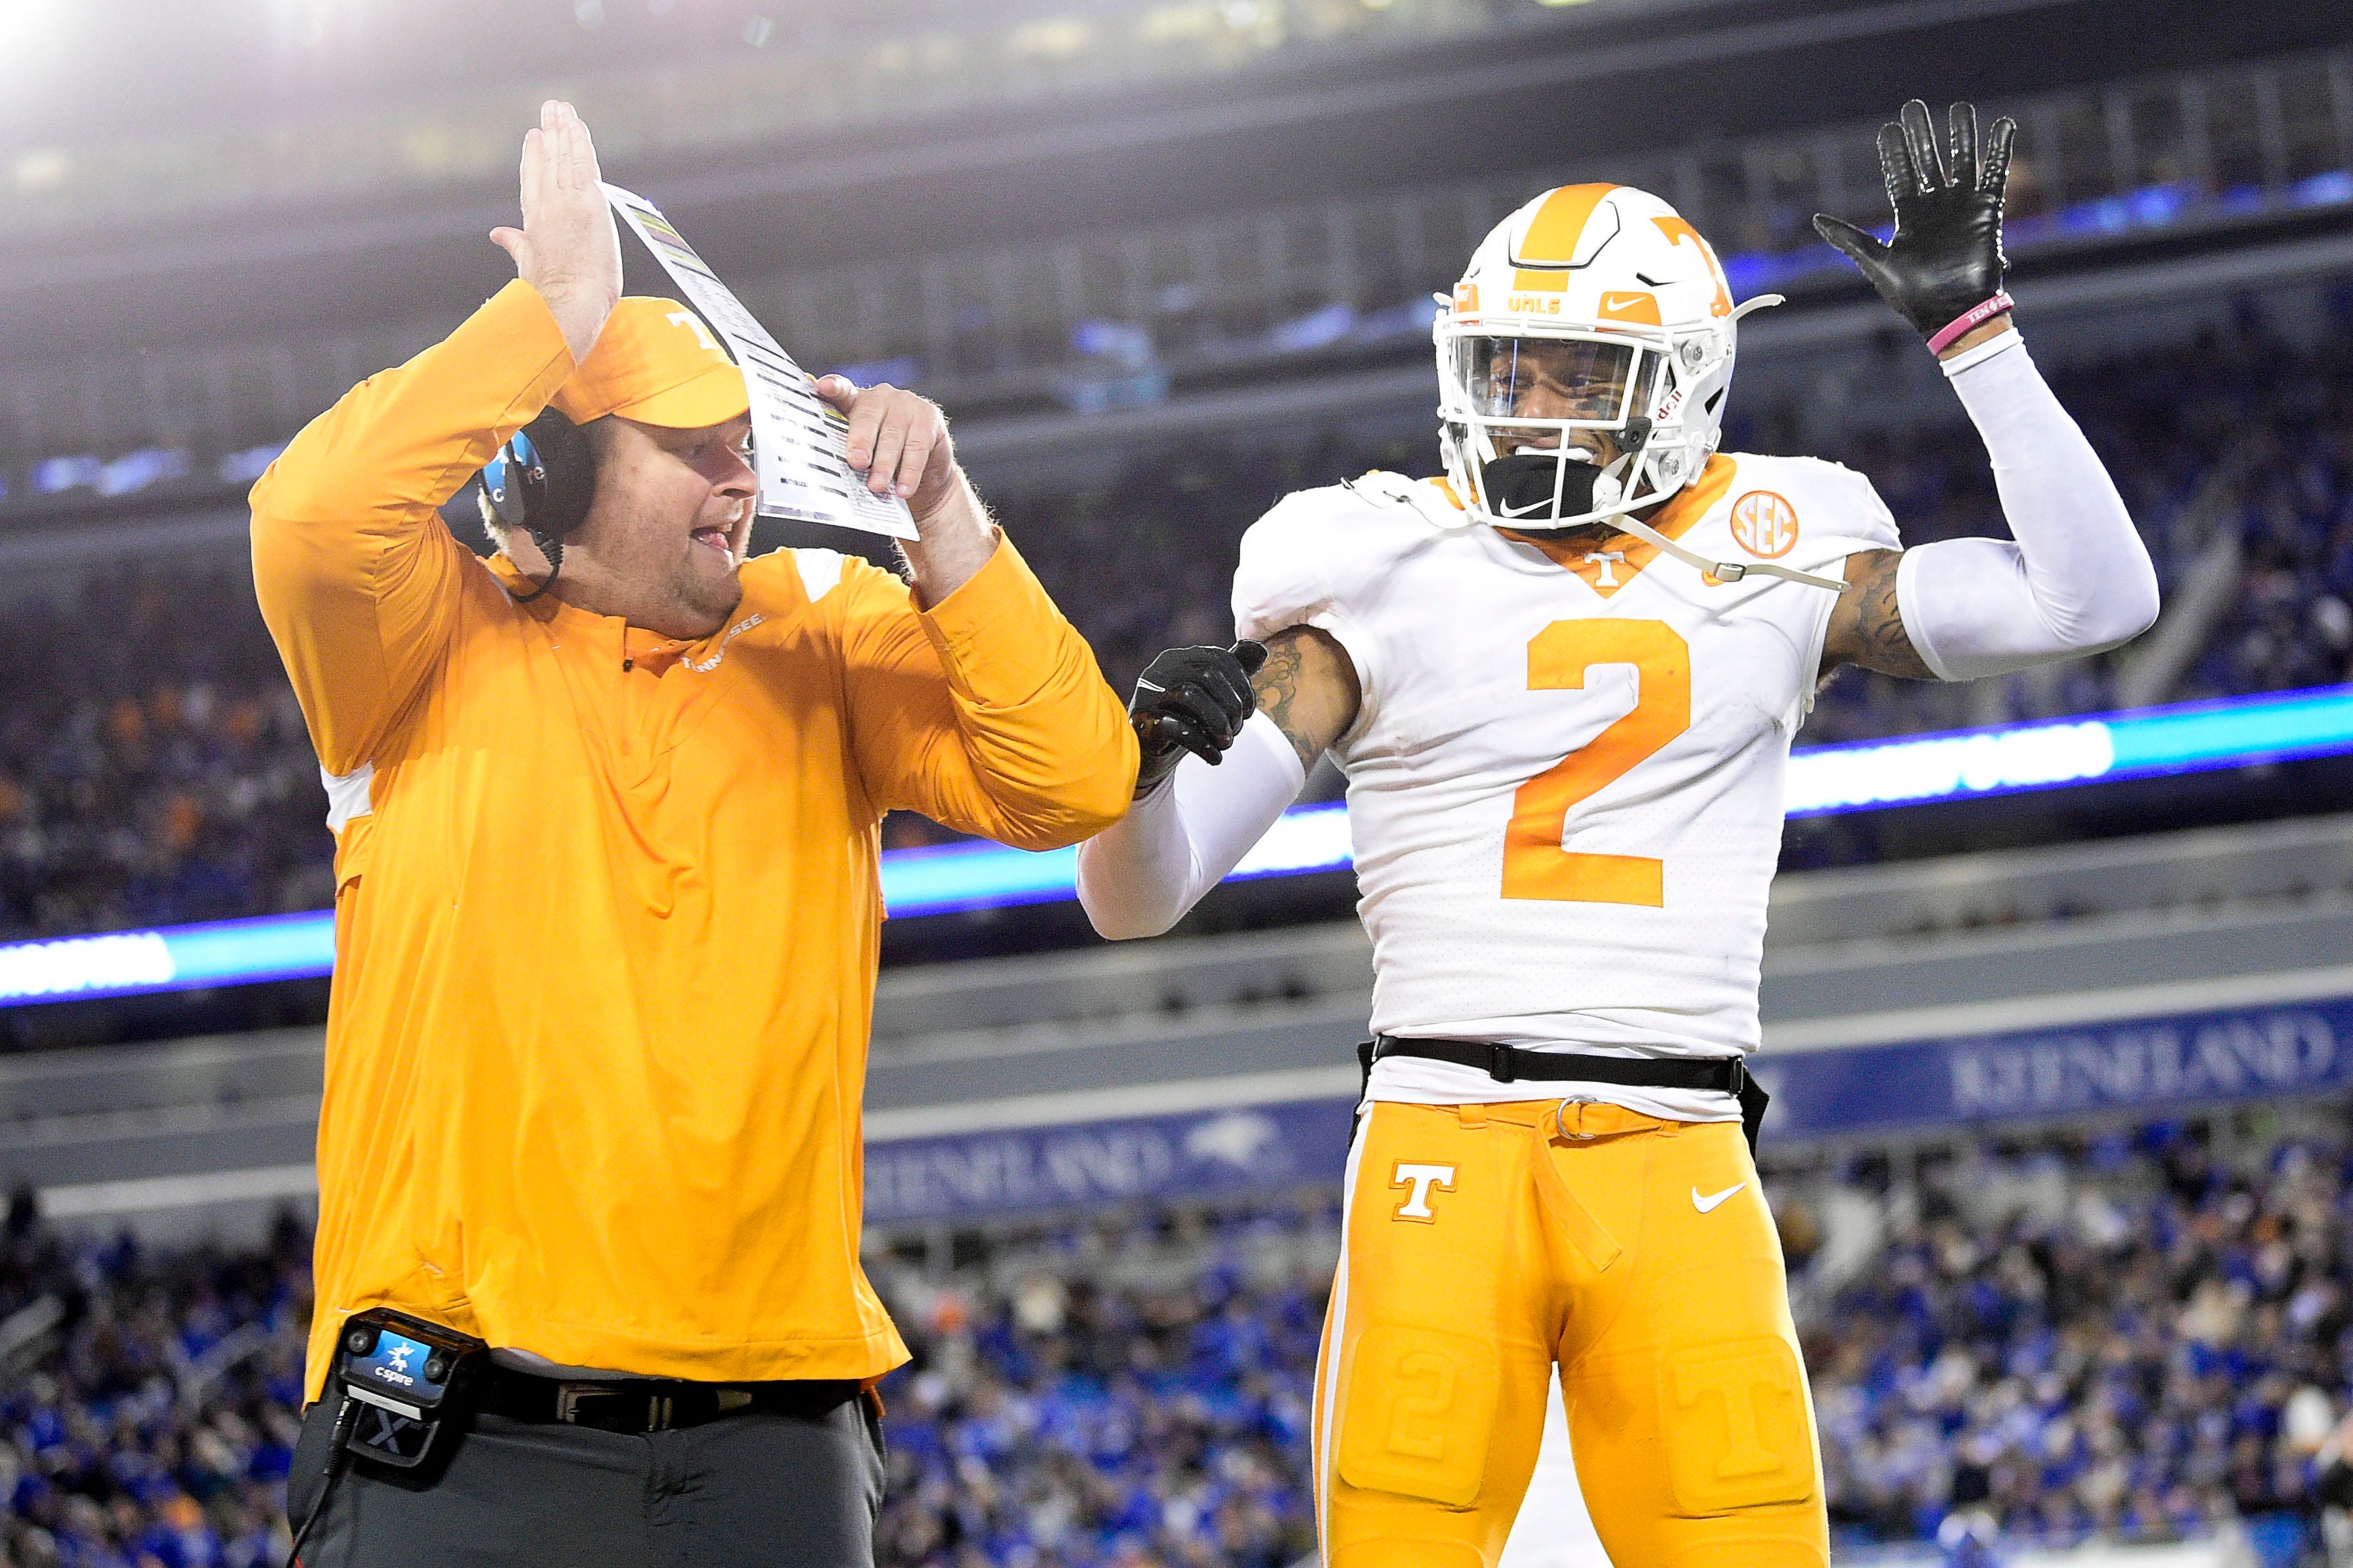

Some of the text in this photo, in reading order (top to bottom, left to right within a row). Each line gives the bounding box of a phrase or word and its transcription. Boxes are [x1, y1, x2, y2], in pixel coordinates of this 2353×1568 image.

[1508, 297, 1561, 315] VOLS
[1658, 390, 1682, 420] dell
[1735, 493, 1793, 556] SEC
[1584, 551, 1625, 587] T
[1501, 618, 1691, 908] 2
[1389, 1160, 1460, 1223] T
